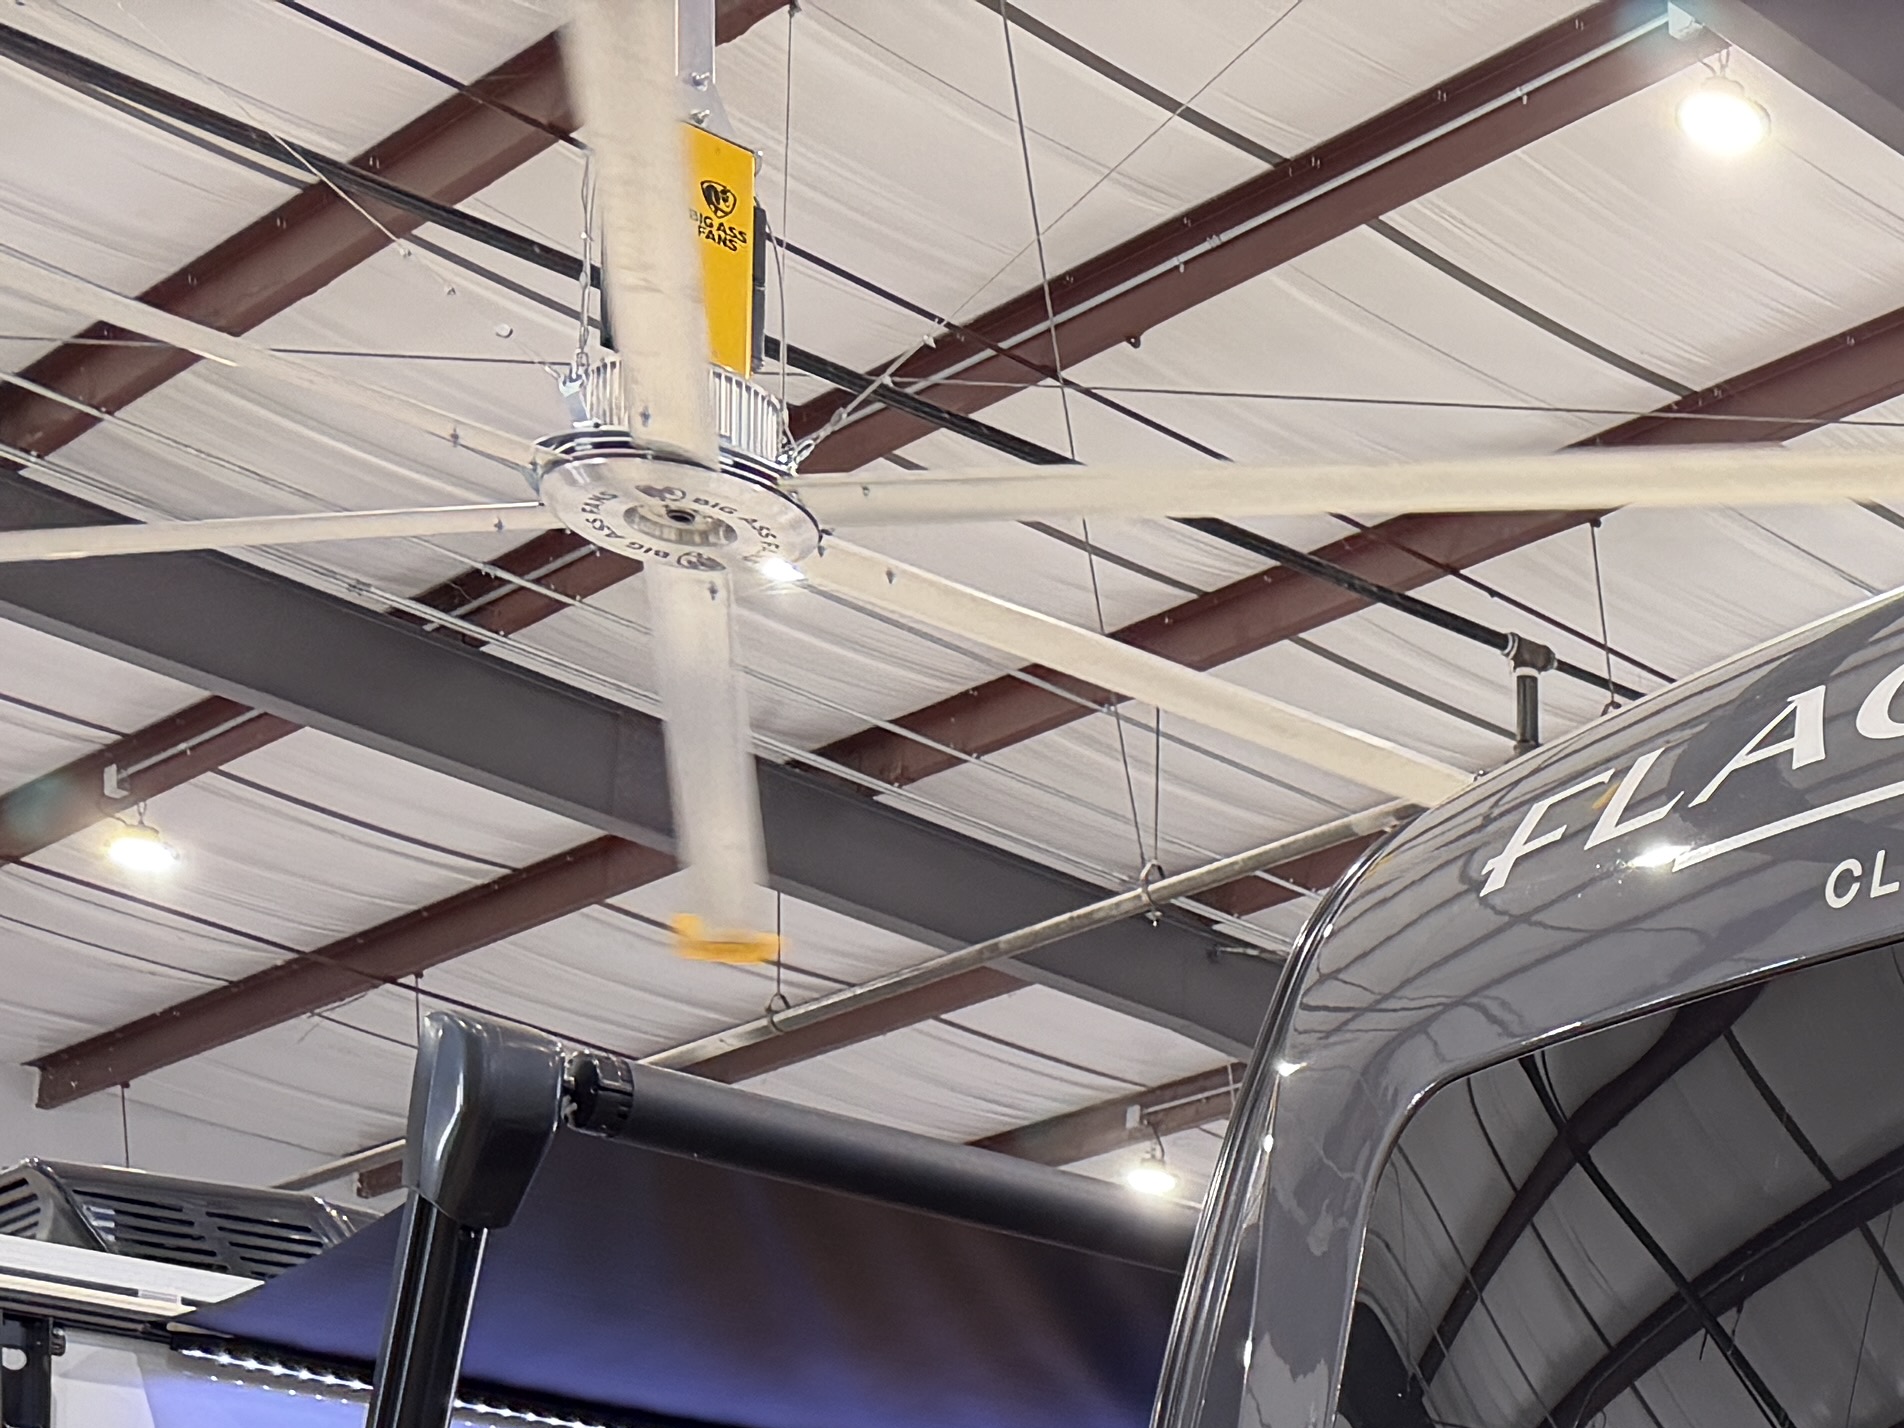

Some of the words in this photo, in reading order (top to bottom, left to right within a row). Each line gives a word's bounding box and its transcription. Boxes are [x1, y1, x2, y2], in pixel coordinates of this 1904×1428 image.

[698, 225, 737, 251] FANS
[716, 222, 747, 243] ASS
[693, 497, 737, 514] BIG
[626, 541, 670, 558] BIG
